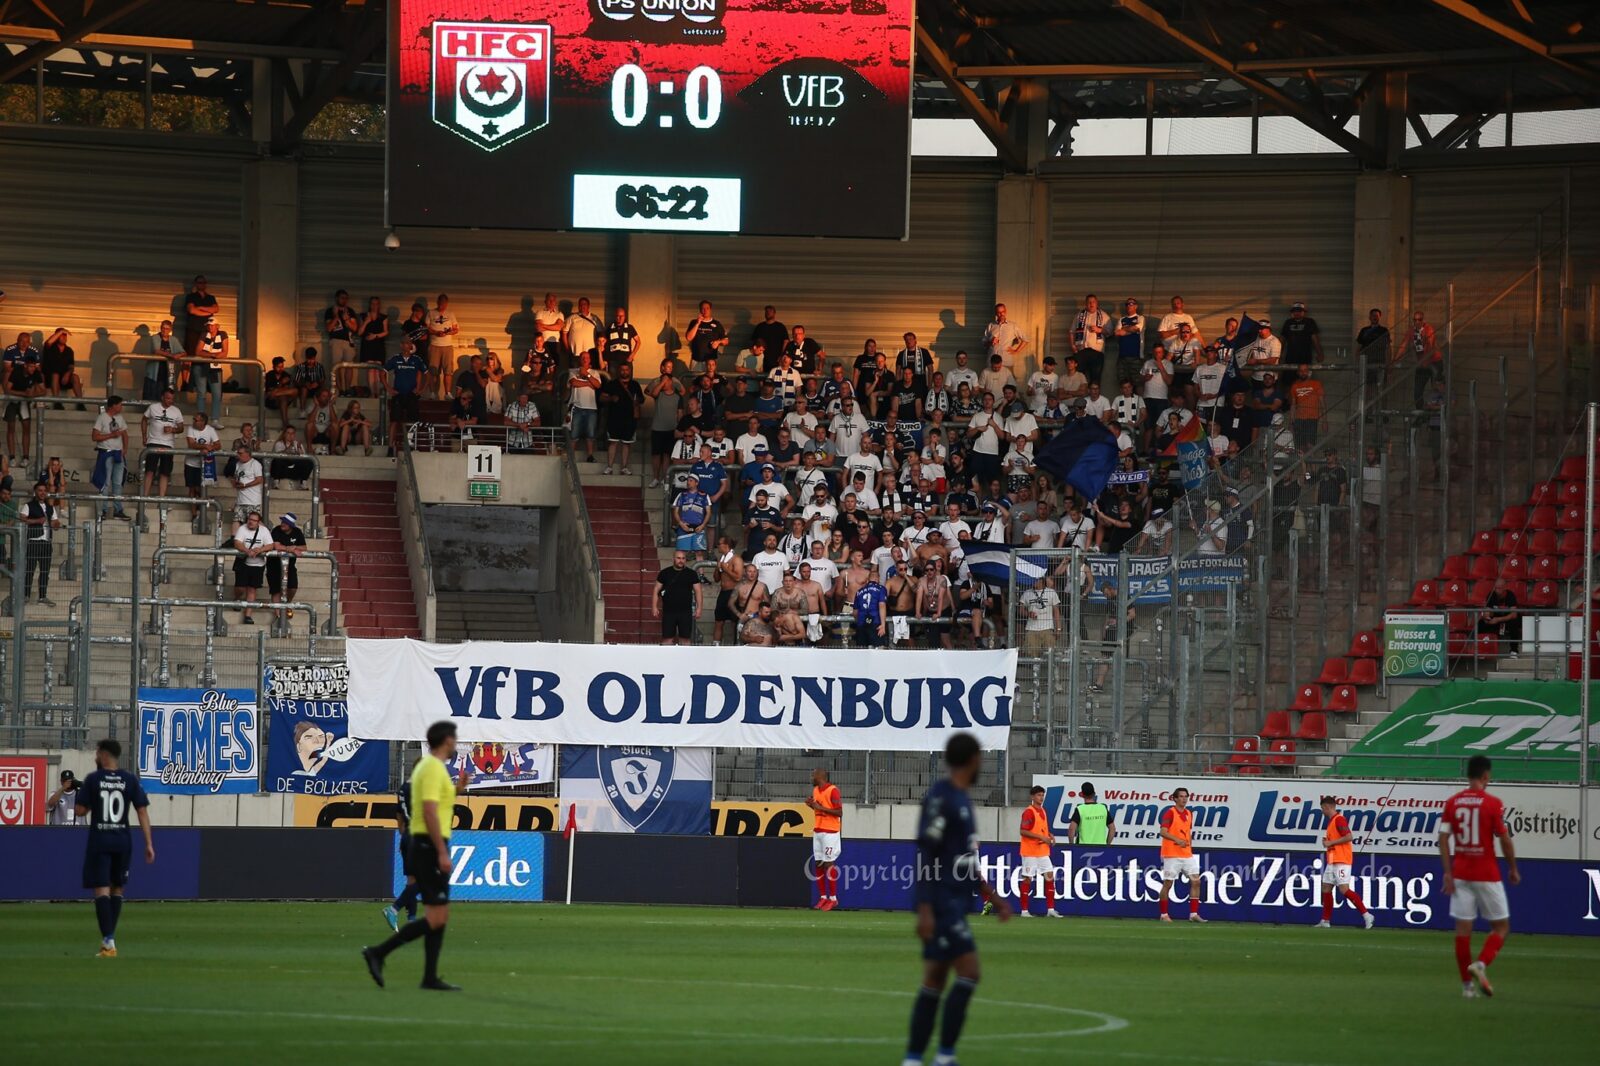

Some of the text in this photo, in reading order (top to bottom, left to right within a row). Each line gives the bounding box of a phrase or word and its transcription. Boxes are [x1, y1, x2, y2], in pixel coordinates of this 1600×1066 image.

[447, 32, 536, 59] HFC
[611, 64, 722, 129] 0:0
[782, 74, 845, 108] VfB
[475, 453, 493, 473] 11
[1388, 640, 1442, 653] Entsorgung
[1394, 629, 1437, 639] Wasser &
[200, 690, 238, 711] Blue
[433, 665, 1012, 730] VfB OLDENBURG
[139, 707, 255, 774] FLAMES
[161, 762, 227, 793] Oldenburg
[276, 777, 368, 796] DE BÖLKERS
[100, 790, 125, 823] 10
[1104, 790, 1229, 802] Wohn-Cetrum
[1455, 807, 1480, 846] 31
